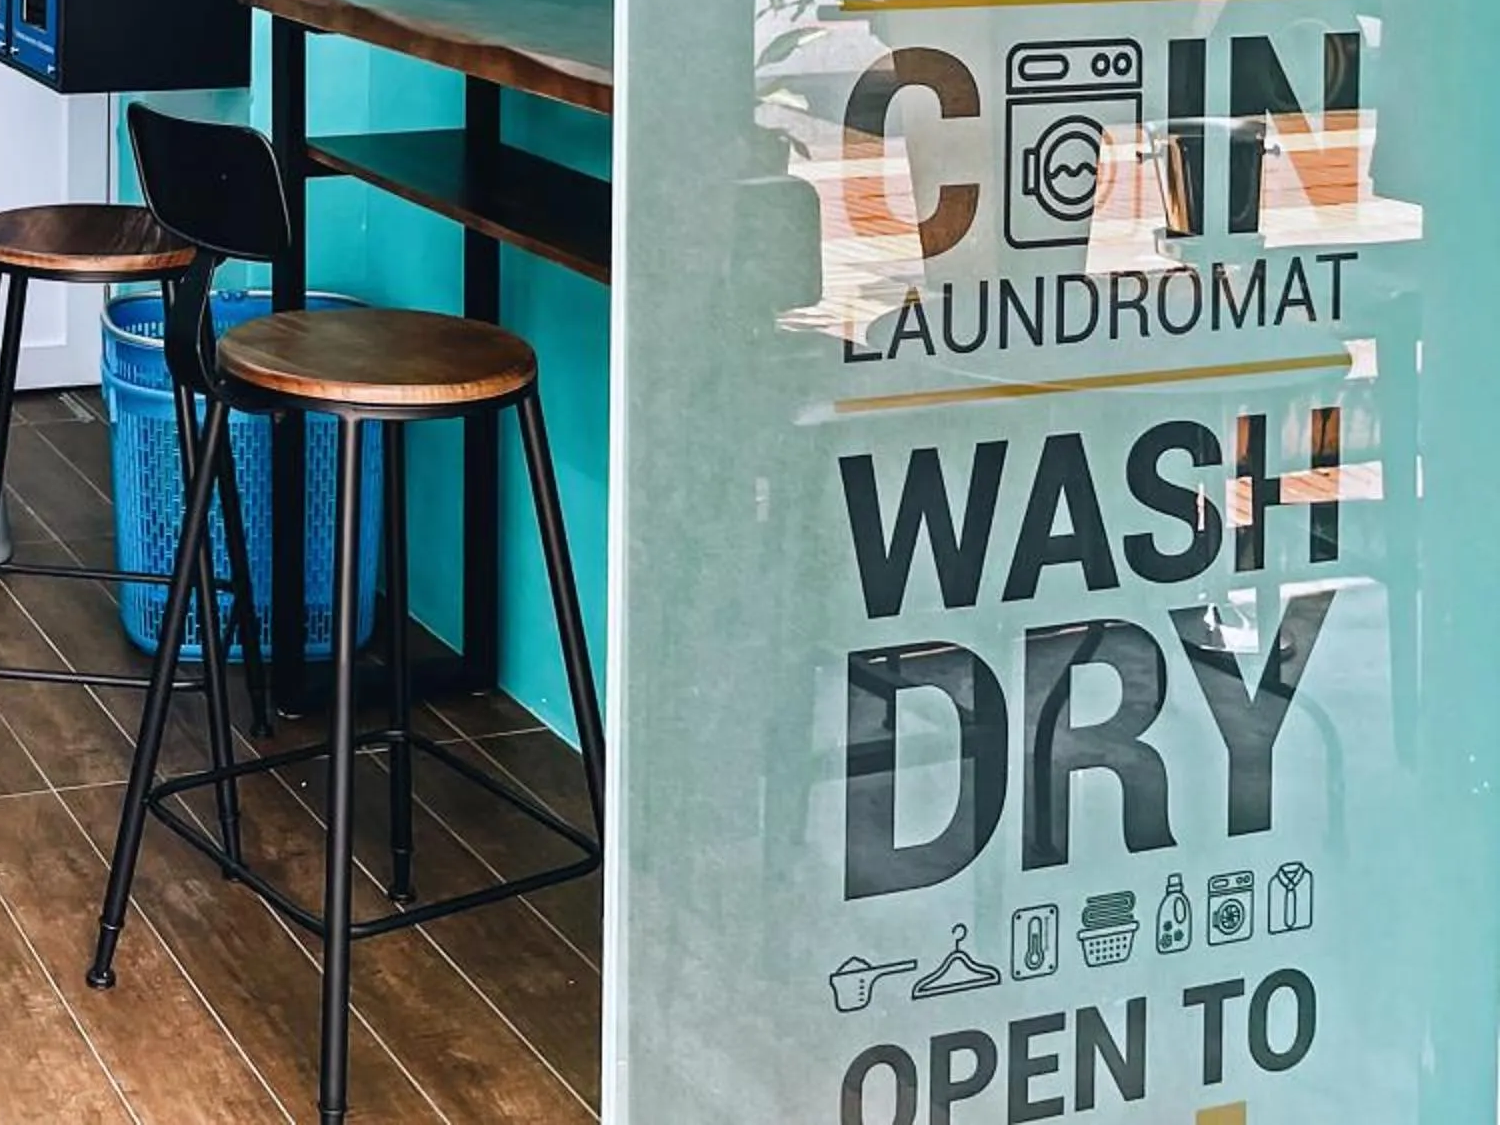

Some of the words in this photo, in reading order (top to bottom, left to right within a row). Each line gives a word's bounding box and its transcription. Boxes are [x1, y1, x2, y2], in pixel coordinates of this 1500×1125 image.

[843, 251, 1359, 364] LAUNDROMAT
[837, 405, 1342, 620] WASH
[844, 590, 1337, 902] DRY
[839, 995, 1148, 1125] OPEN
[1182, 966, 1317, 1086] TO
